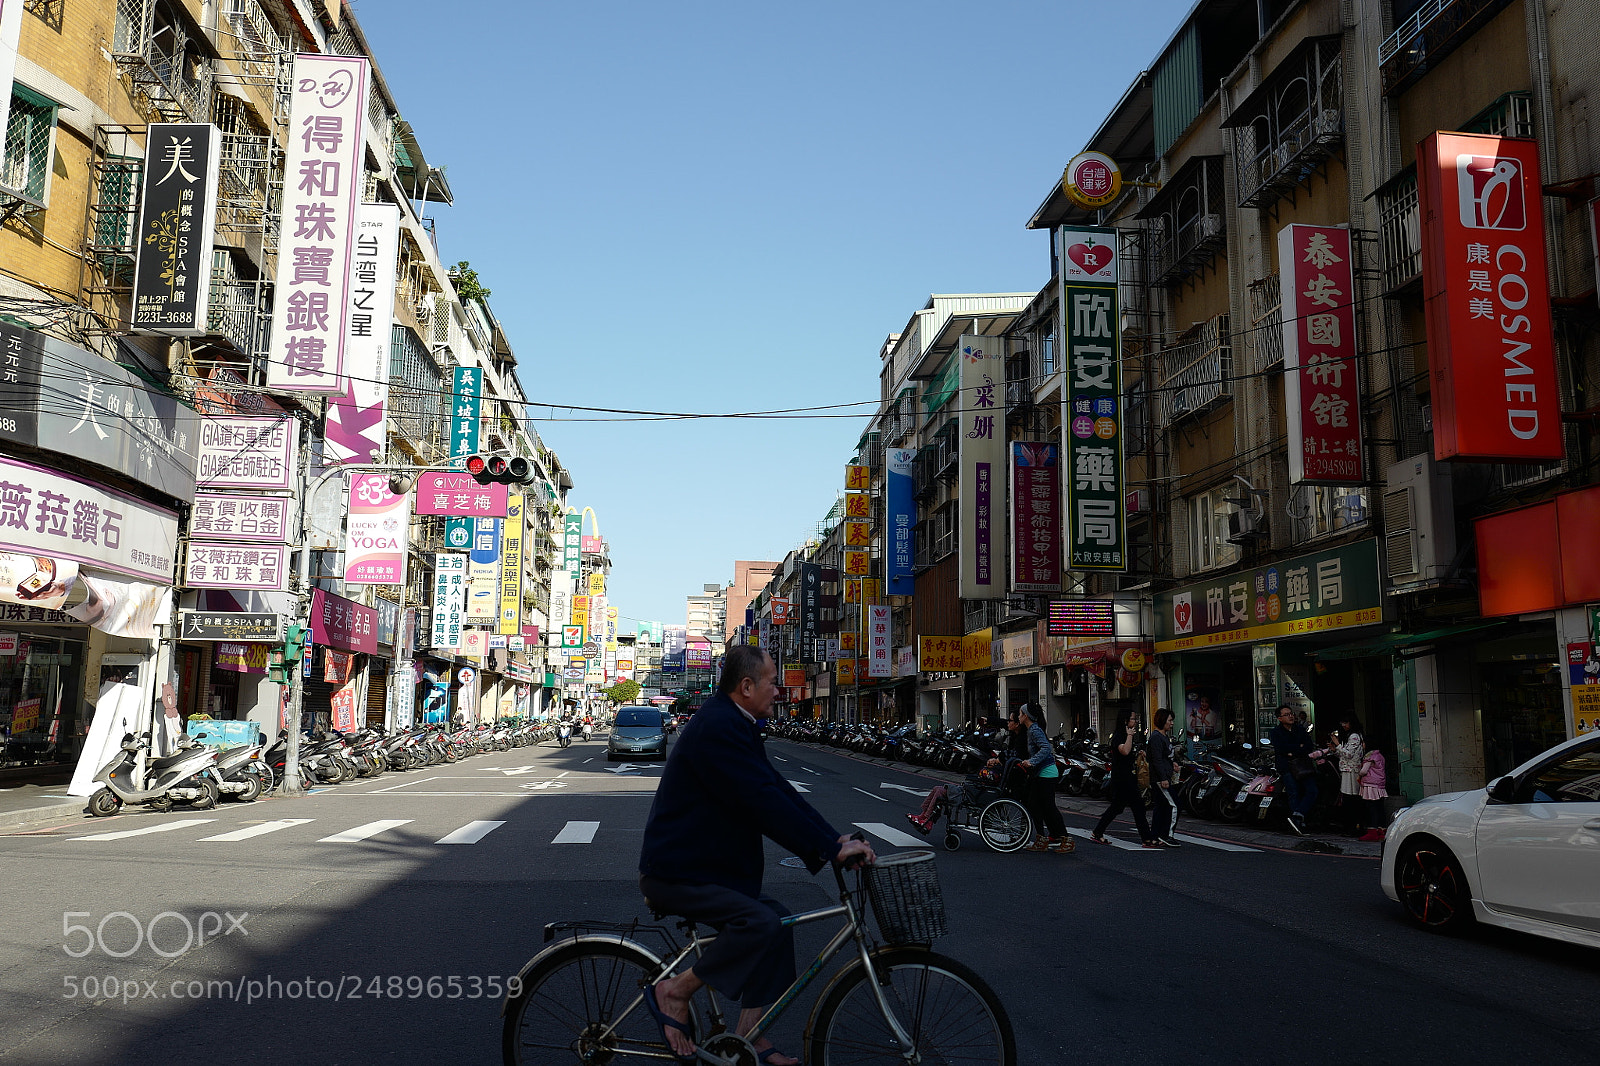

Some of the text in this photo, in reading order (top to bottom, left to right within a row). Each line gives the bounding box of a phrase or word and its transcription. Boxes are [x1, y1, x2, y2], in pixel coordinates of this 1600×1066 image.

[155, 135, 201, 186] 美
[283, 115, 343, 379] 得和珠寶銀樓
[1465, 242, 1494, 320] 康是美
[137, 311, 193, 323] 2231-3688
[1301, 232, 1350, 429] 泰安國術館
[1073, 293, 1112, 390] 欣安
[1495, 244, 1539, 440] COSMED
[1075, 400, 1114, 414] 健康
[203, 424, 284, 450] GIA鑽石專賣店
[1075, 420, 1113, 434] 生活
[1303, 437, 1358, 456] 請上二樓
[432, 494, 491, 510] 喜芝梅
[1075, 446, 1117, 546] 藥局
[196, 500, 281, 519] 高價收購
[351, 538, 398, 549] YOGA
[191, 548, 278, 567] 艾薇菈鑽石
[438, 556, 463, 569] 主治
[189, 565, 276, 583] 得和珠寶
[1285, 557, 1343, 613] 藥局
[1206, 581, 1249, 628] 欣安
[187, 614, 204, 634] 美
